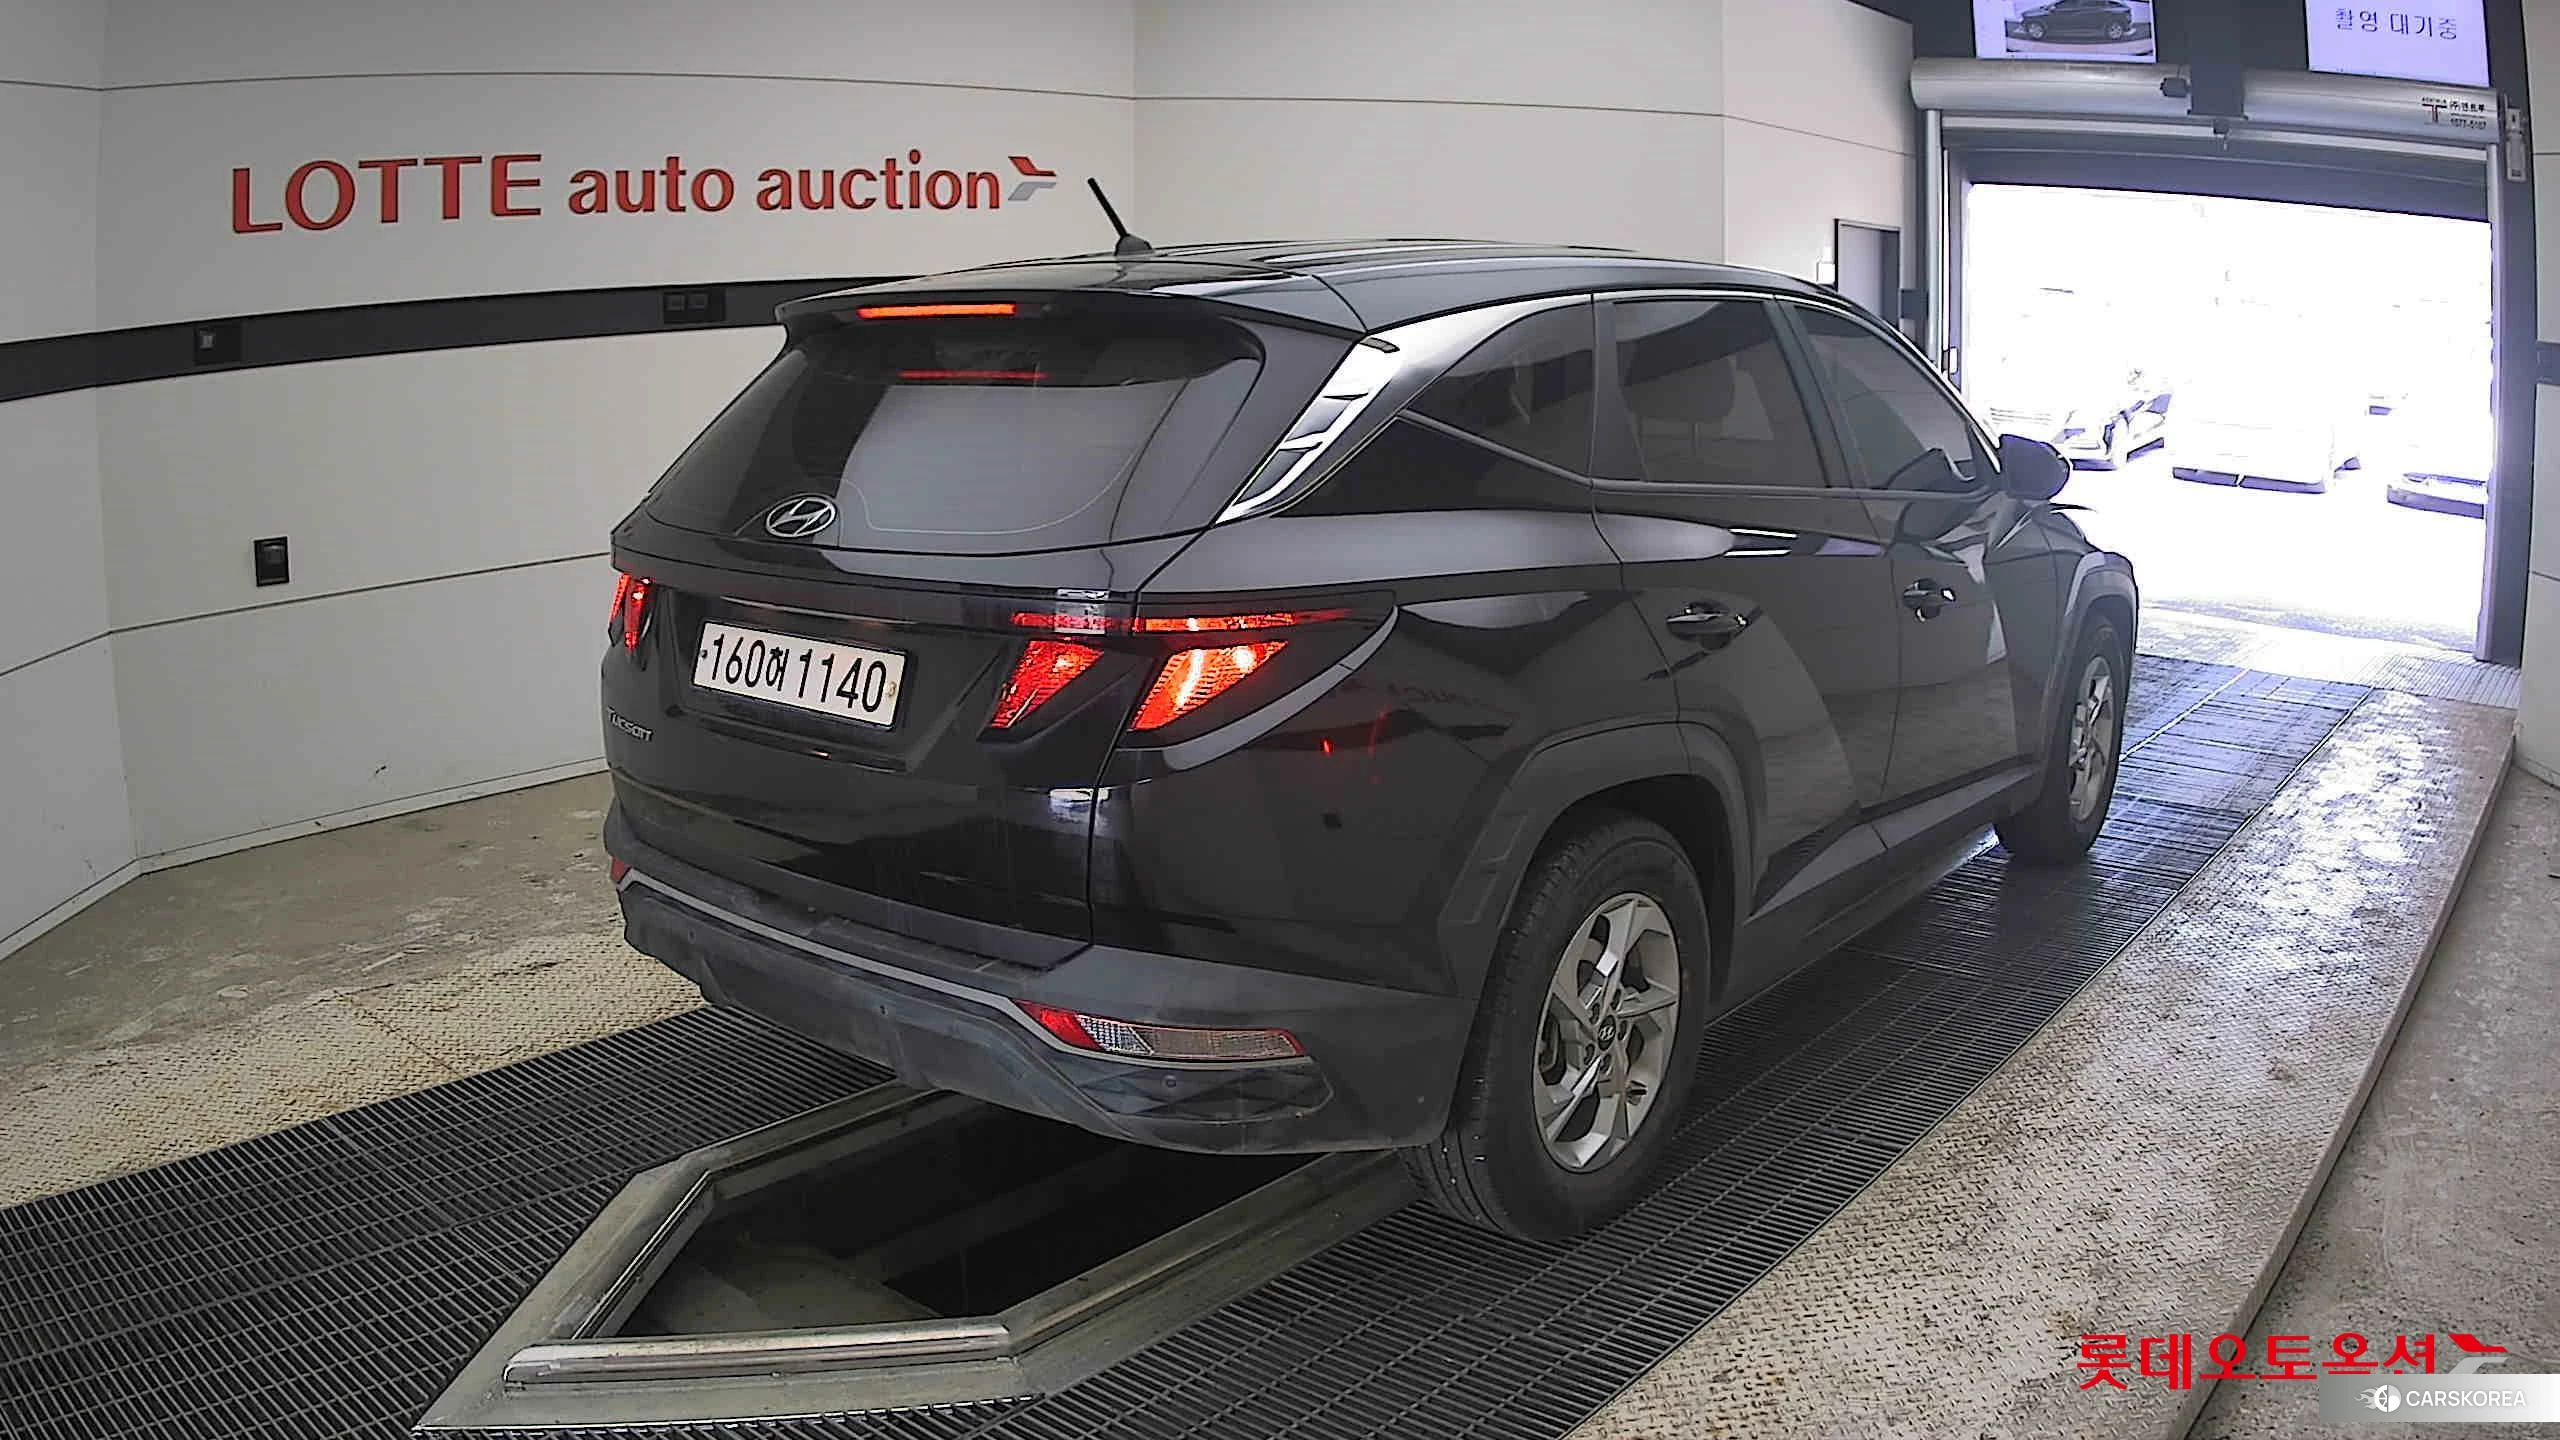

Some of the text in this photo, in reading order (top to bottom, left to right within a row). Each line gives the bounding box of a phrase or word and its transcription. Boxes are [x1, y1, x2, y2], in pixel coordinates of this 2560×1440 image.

[232, 150, 1001, 234] LOTTE auto auction
